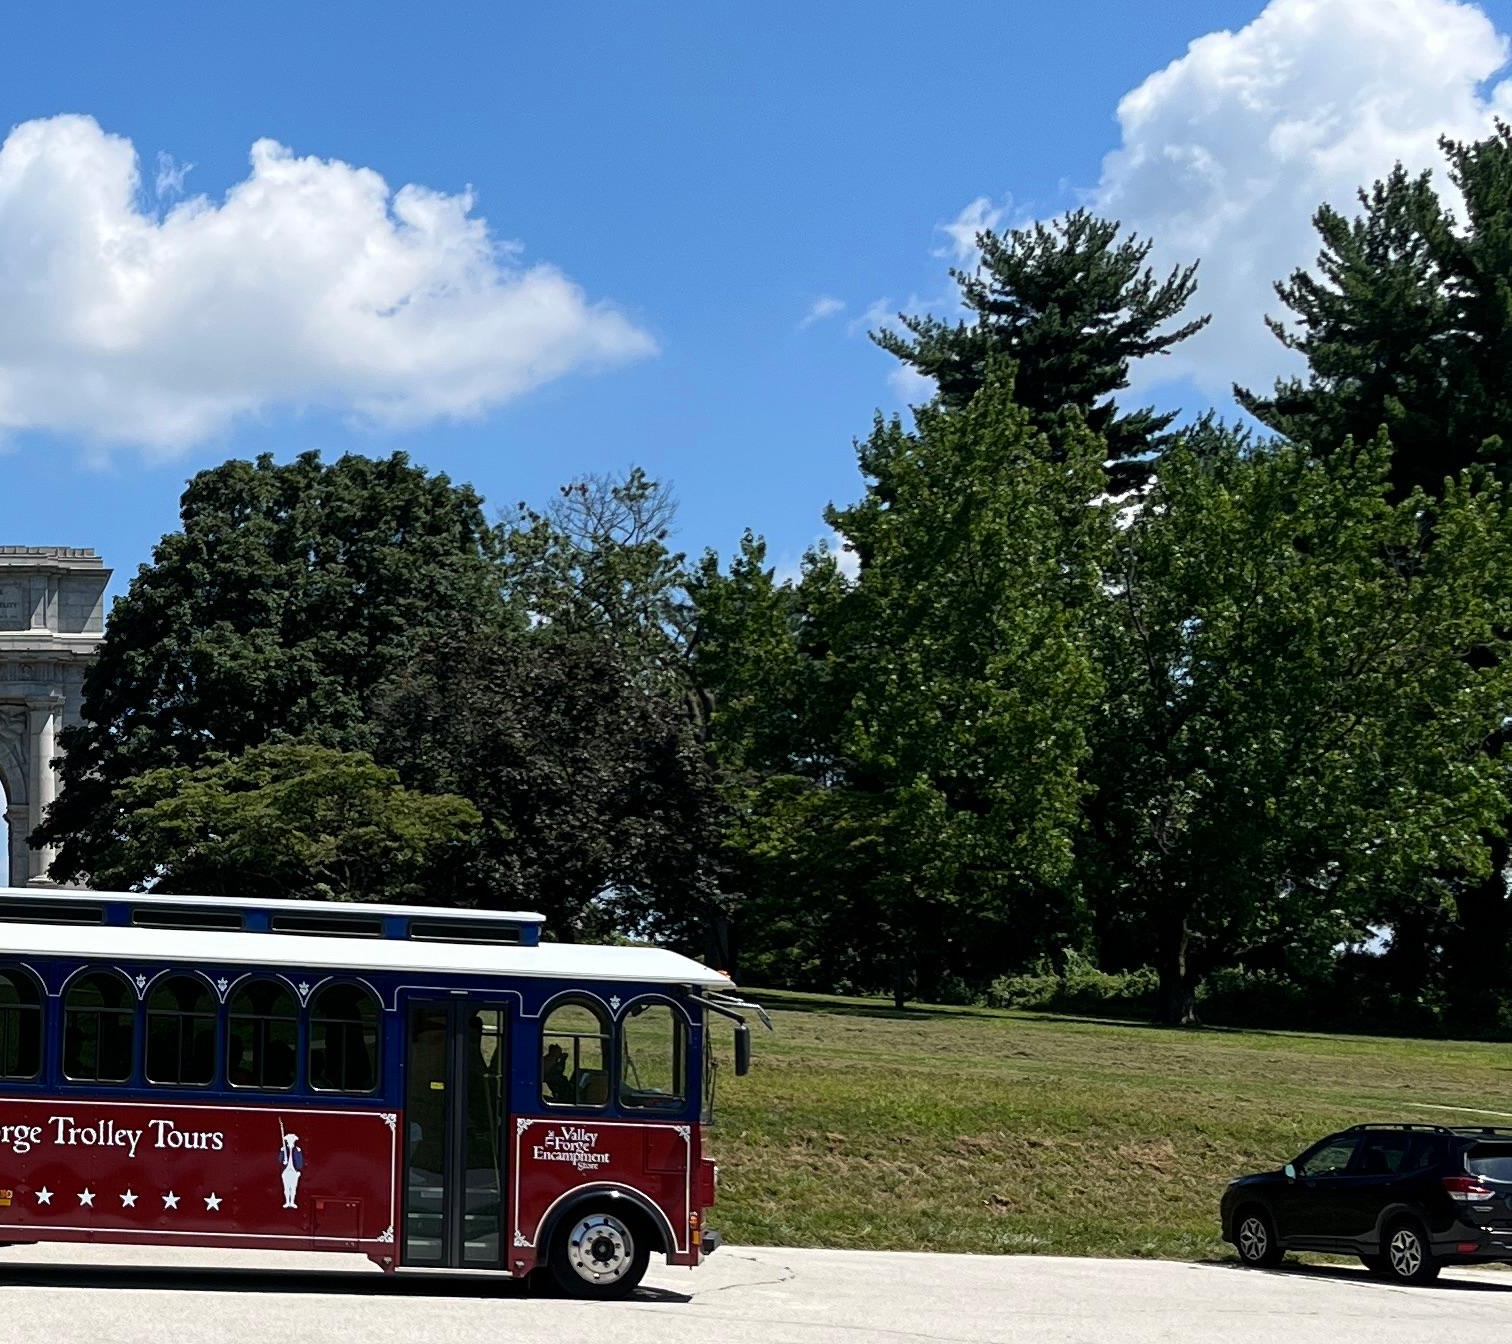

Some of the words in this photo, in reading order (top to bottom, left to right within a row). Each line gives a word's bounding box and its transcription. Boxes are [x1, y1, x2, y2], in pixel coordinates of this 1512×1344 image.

[48, 1116, 143, 1158] Trolley
[148, 1119, 224, 1150] Tours
[554, 1136, 590, 1154] Forge
[560, 1126, 598, 1147] Valley
[533, 1145, 610, 1165] Encampment
